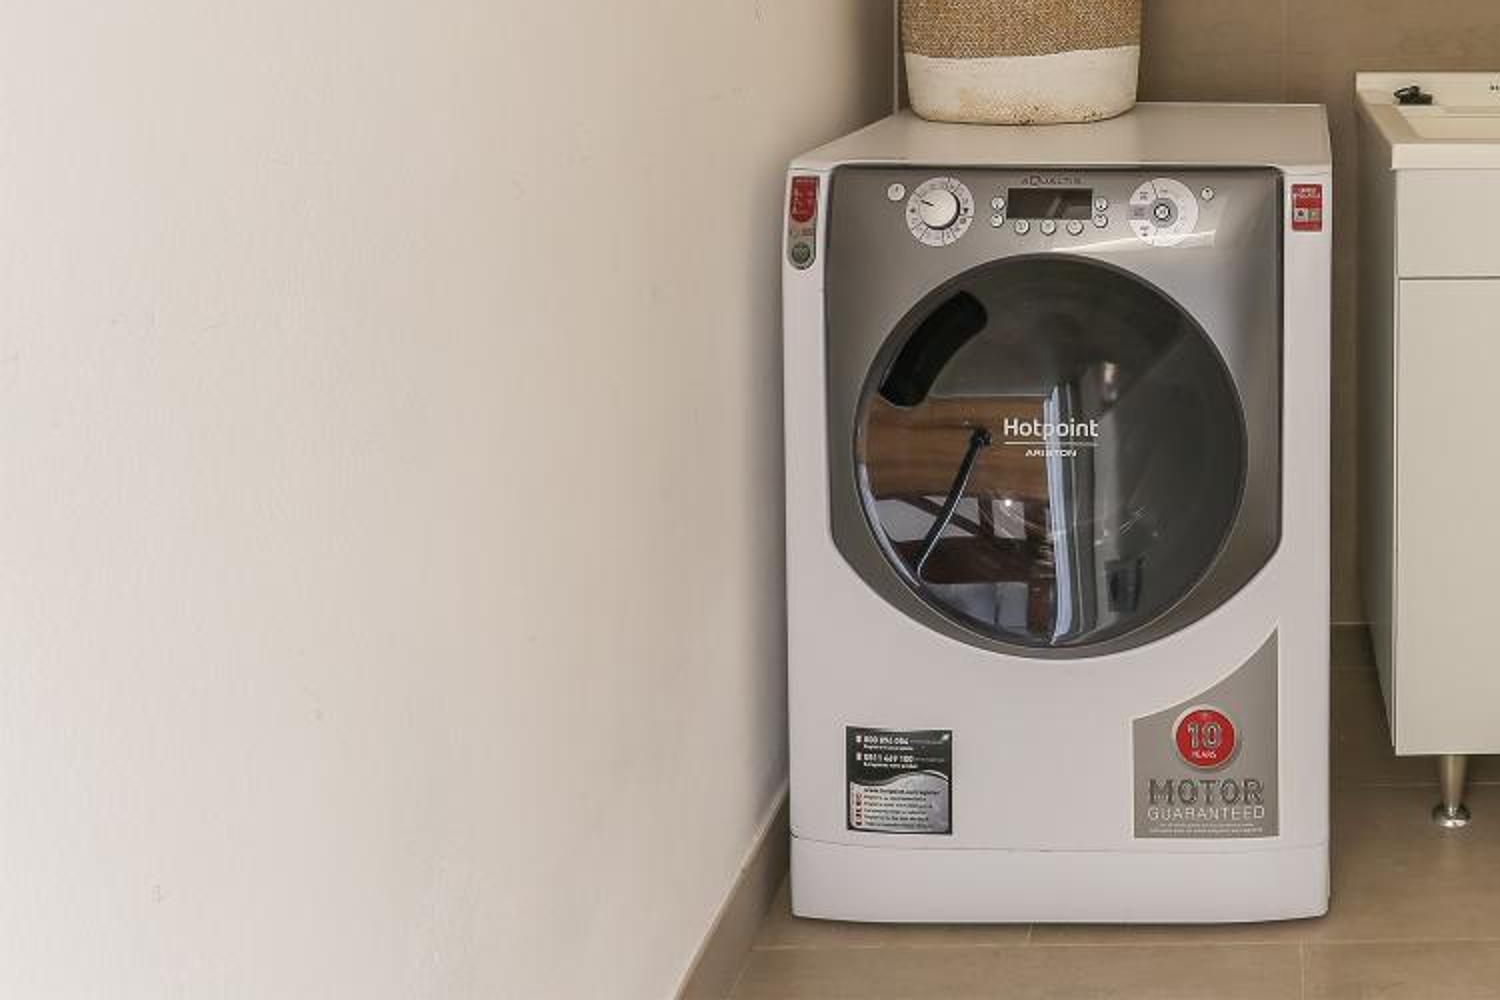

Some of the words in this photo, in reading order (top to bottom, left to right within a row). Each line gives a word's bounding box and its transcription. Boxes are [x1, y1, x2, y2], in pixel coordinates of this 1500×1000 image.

[1004, 417, 1098, 440] Hotpoint
[1188, 722, 1221, 749] 10
[1149, 779, 1264, 805] MOTOR
[1148, 805, 1265, 821] GUARANTEED
